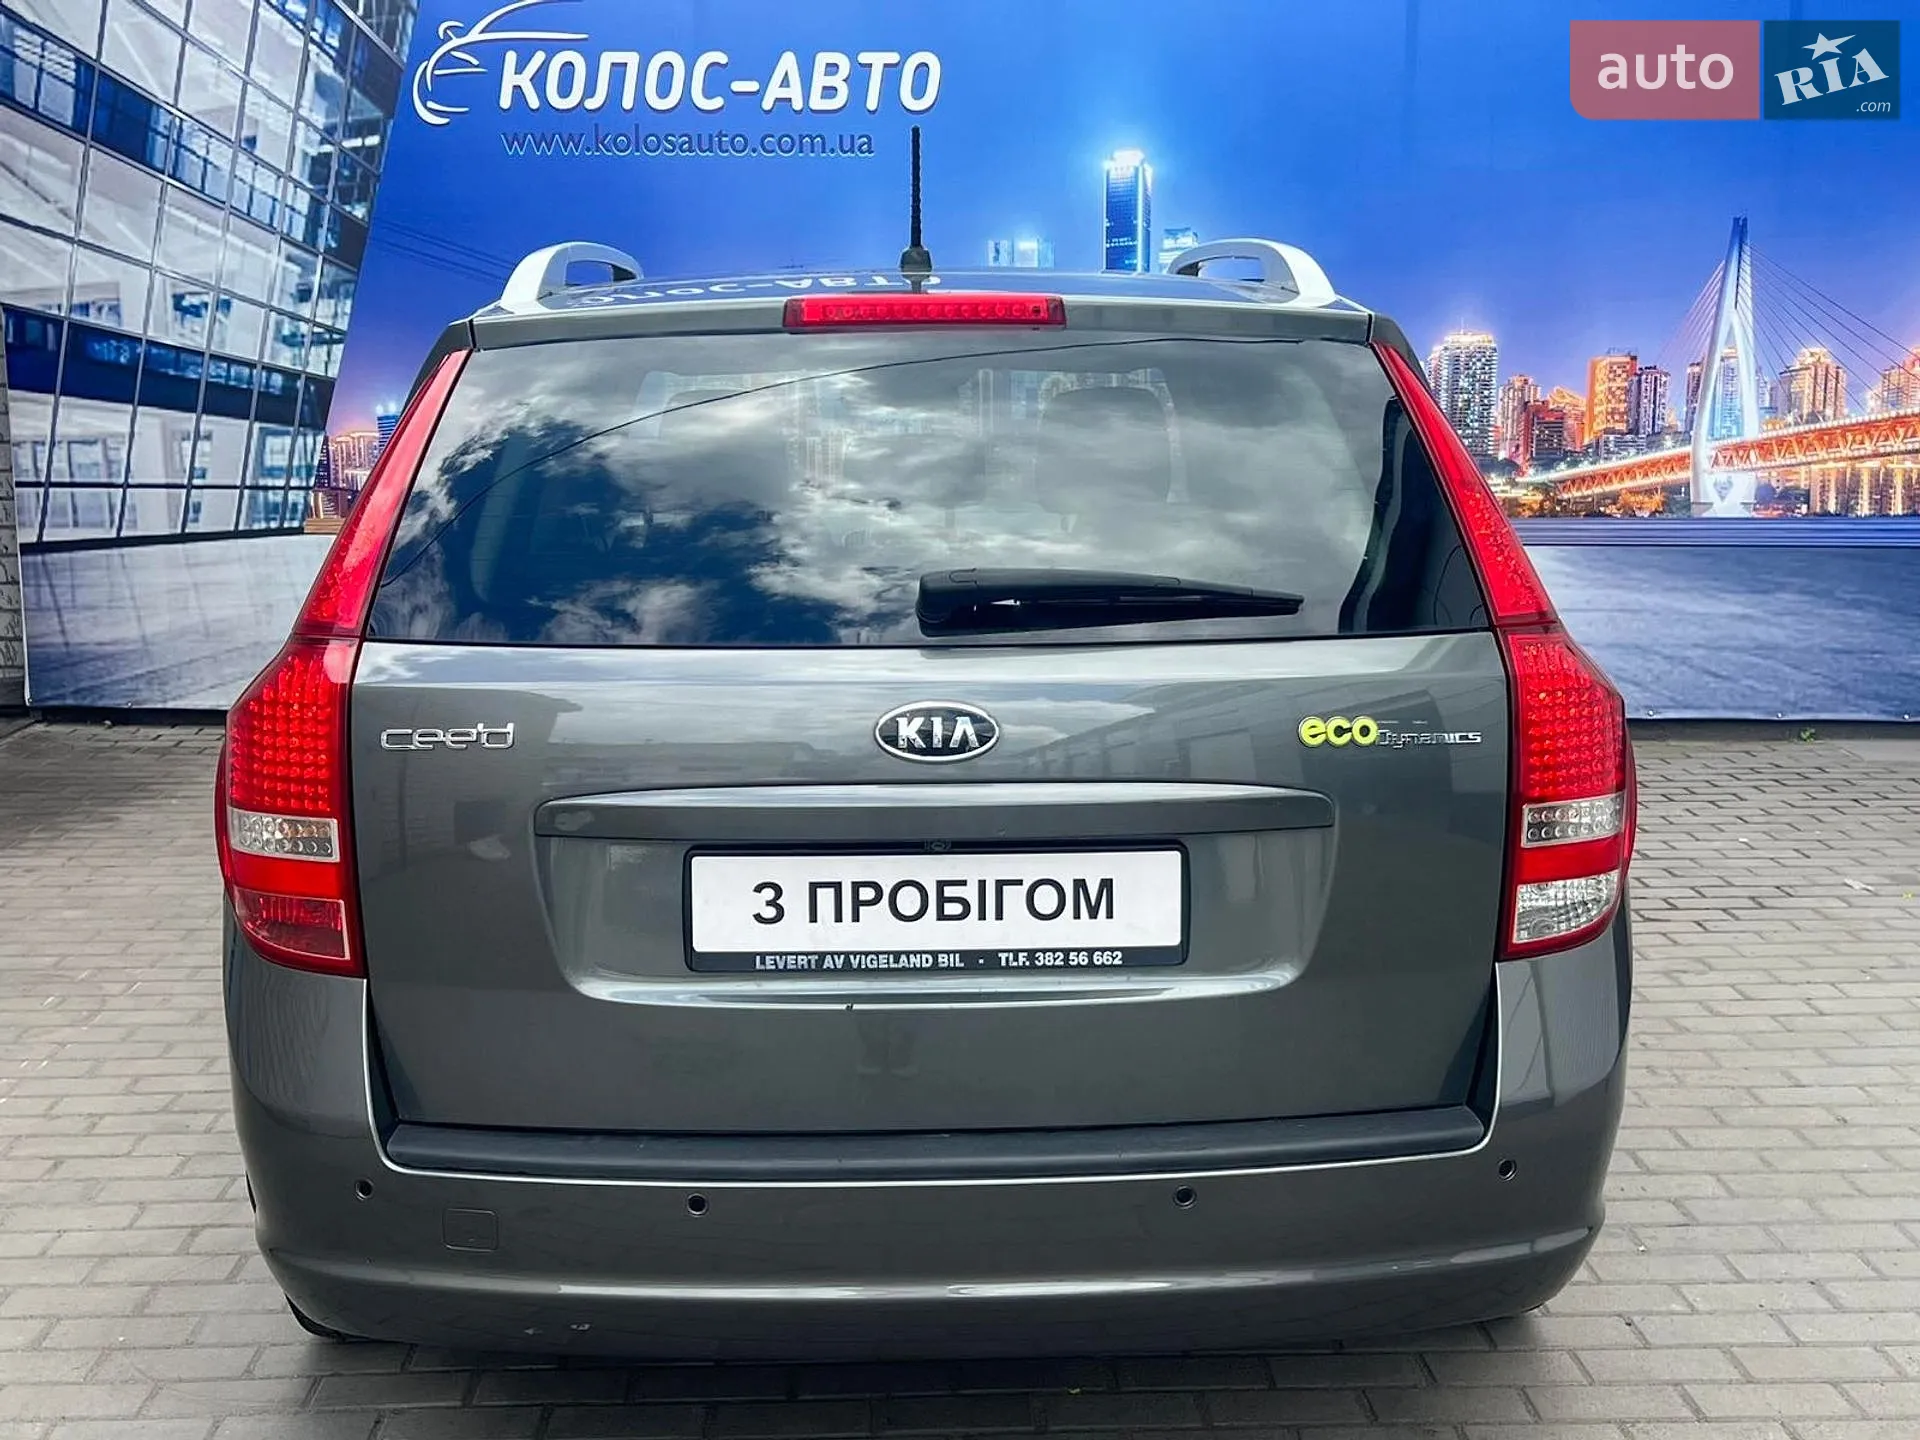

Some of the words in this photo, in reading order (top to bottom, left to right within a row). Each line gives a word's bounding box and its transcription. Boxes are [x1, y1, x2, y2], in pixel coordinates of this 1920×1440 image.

[499, 50, 942, 113] КОЛОС-АВТО
[500, 123, 875, 158] www.kolosauto.com.ua
[895, 716, 980, 748] KIA
[807, 877, 1115, 924] ПРОБІГОМ
[755, 954, 819, 970] LEVERT
[822, 954, 846, 969] AV
[849, 954, 933, 969] VIGELAND
[936, 953, 965, 968] BIL
[998, 952, 1030, 967] TLF.
[1034, 951, 1065, 967] 382
[1068, 951, 1089, 966] 56
[1092, 951, 1123, 966] 662
